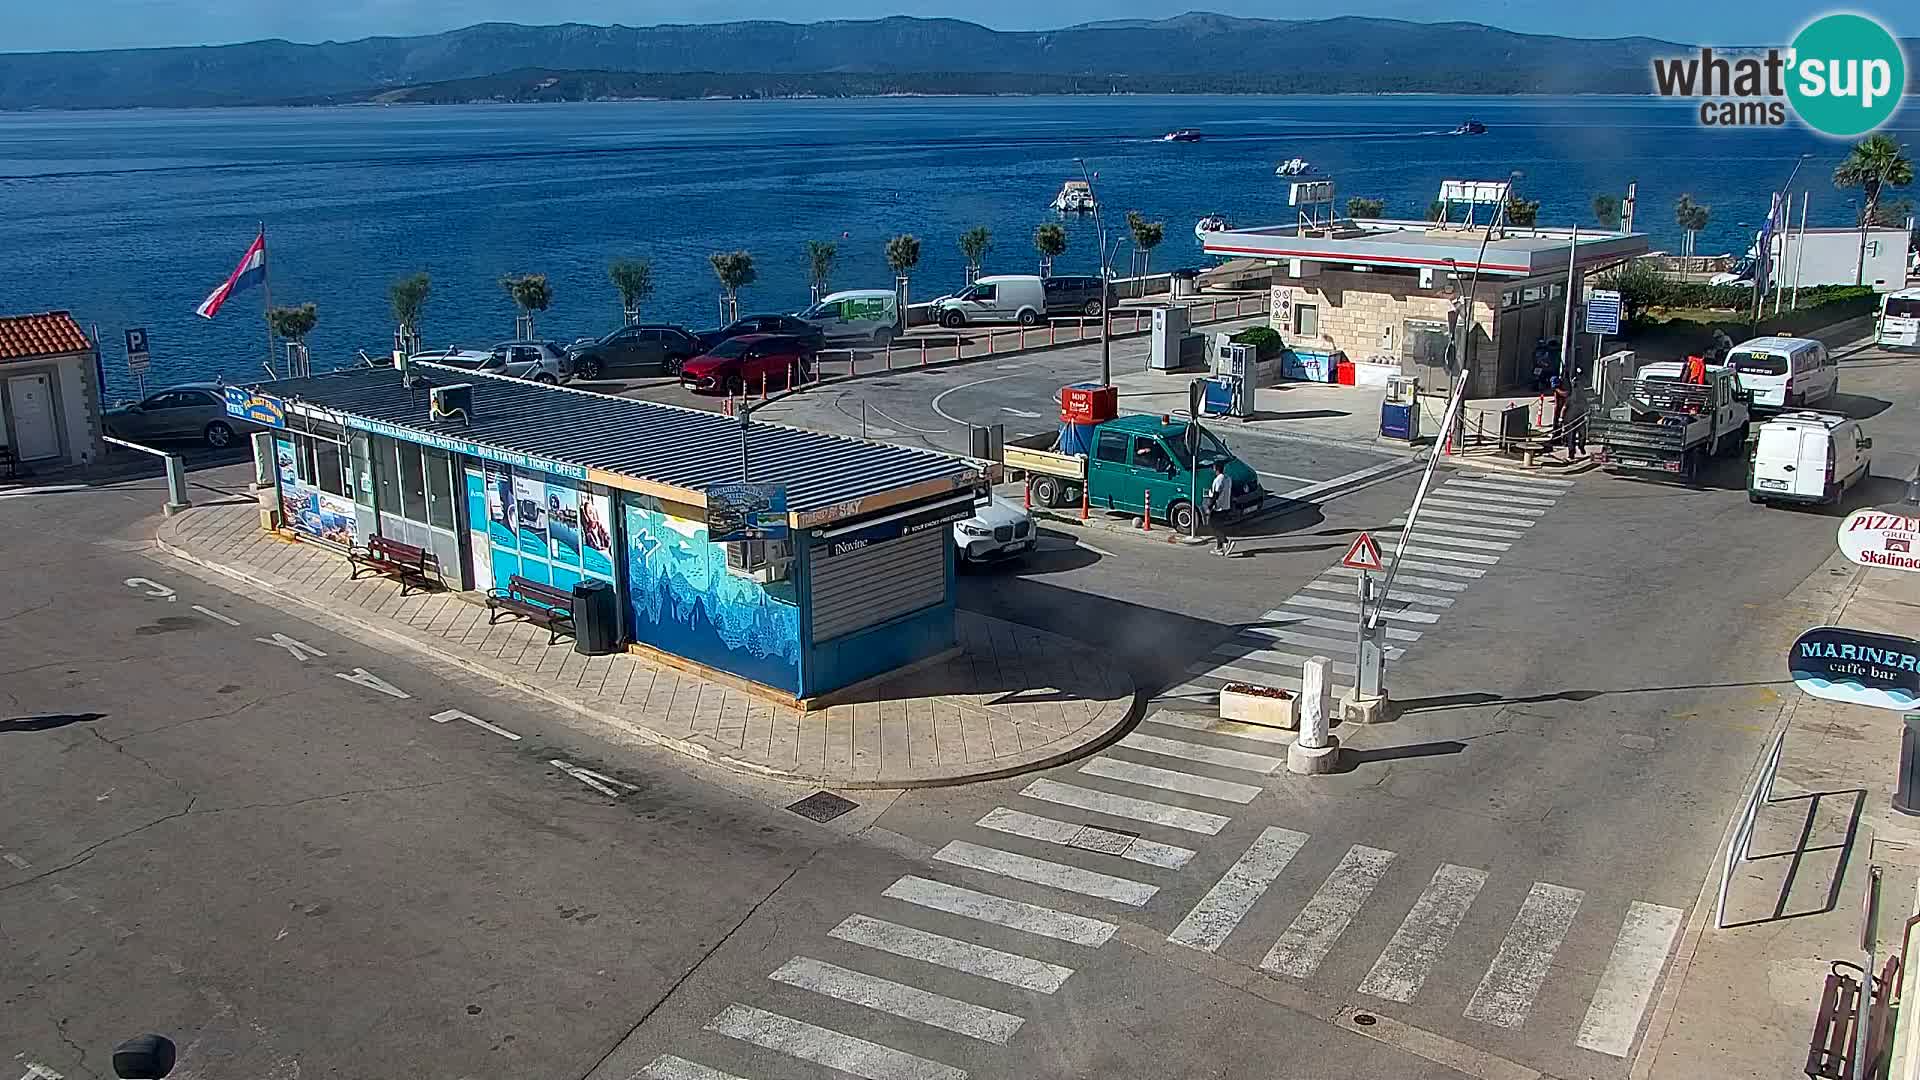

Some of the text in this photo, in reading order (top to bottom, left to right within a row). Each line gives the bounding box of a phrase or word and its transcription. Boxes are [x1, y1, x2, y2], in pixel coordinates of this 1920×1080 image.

[1751, 352, 1769, 361] TAXI
[436, 437, 468, 452] POSTAJA
[477, 447, 493, 459] BUS
[493, 450, 526, 465] STATION
[527, 457, 553, 471] TICKET
[555, 462, 582, 478] OFFICE
[1848, 516, 1920, 533] PIZZE
[1882, 530, 1917, 541] GRILL
[1829, 662, 1898, 681] caffe bar
